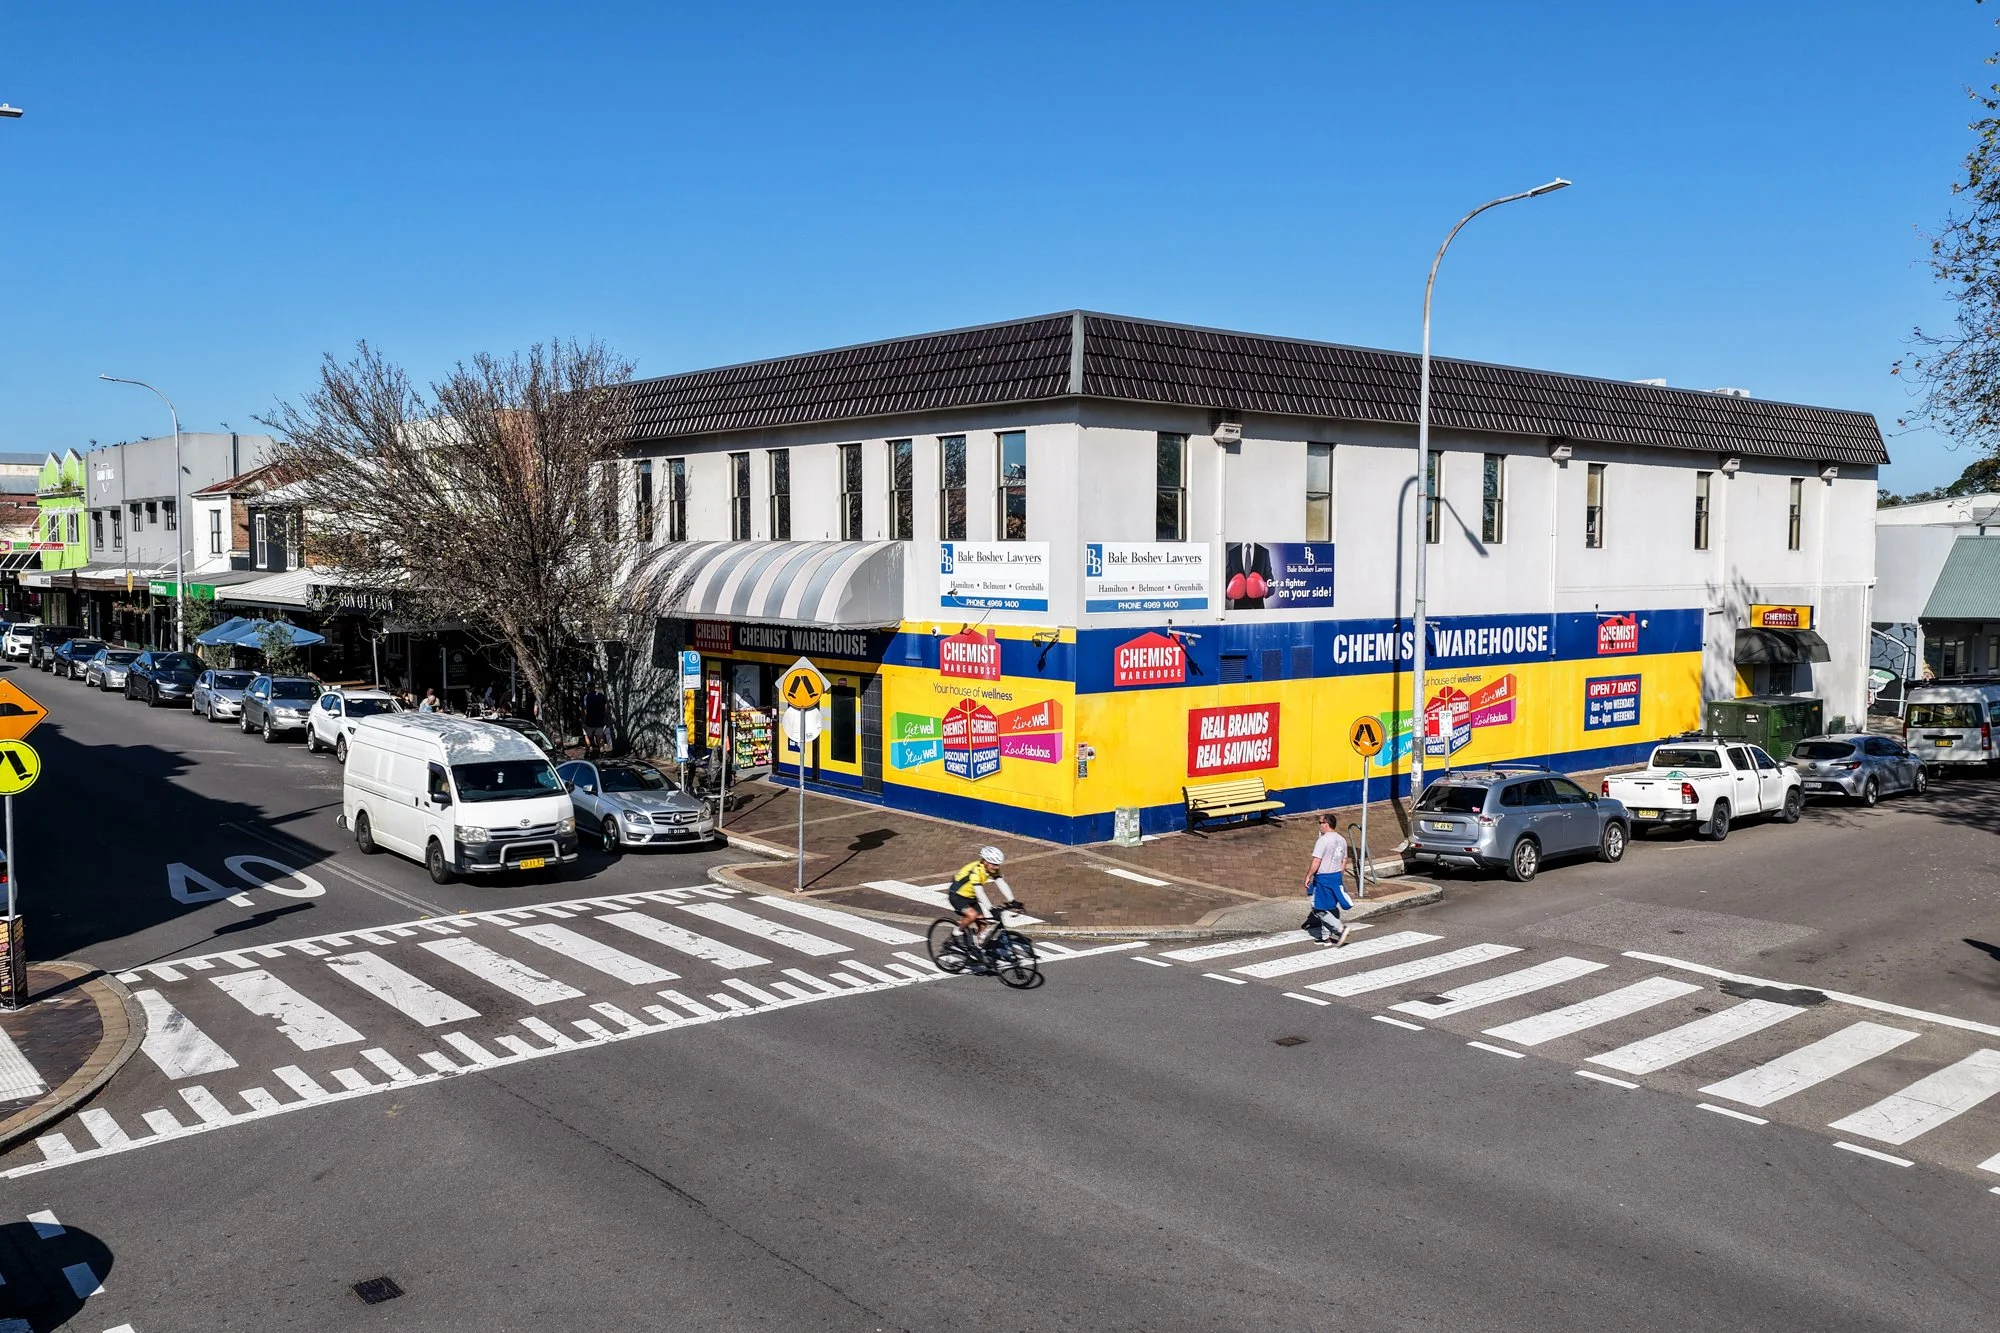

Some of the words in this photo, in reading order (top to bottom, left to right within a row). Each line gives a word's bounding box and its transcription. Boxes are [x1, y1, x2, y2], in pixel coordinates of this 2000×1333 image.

[958, 551, 974, 562] Bale
[976, 551, 1004, 562] Boshev
[1007, 552, 1042, 565] Lawyers
[1108, 551, 1128, 563] Bale
[1131, 551, 1163, 563] Boshev
[1166, 552, 1202, 565] Lawyers
[1287, 565, 1298, 573] Bale
[1298, 565, 1315, 573] Boshev
[950, 580, 975, 589] Hamilton
[983, 581, 1006, 590] Belmont
[1015, 582, 1044, 592] Greenhills
[1098, 584, 1128, 593] Hamilton
[1138, 584, 1165, 592] Belmont
[1174, 583, 1204, 592] Greenhills
[1266, 579, 1279, 587] Get
[1285, 580, 1307, 589] fighter
[1279, 590, 1290, 598] on
[1291, 589, 1310, 600] your
[1312, 586, 1332, 598] side!
[966, 599, 986, 607] PHONE
[1004, 600, 1020, 608] 1400
[1118, 601, 1141, 609] PHONE
[1143, 601, 1161, 609] 4969
[1162, 600, 1179, 608] 1400
[1764, 613, 1797, 621] CHEMIST
[695, 622, 731, 641] CHEMIST
[1600, 625, 1636, 641] CHEMIST
[696, 640, 732, 651] WAREHOUSE
[739, 626, 787, 649] CHEMIST
[791, 630, 867, 656] WAREHOUSE
[1333, 630, 1417, 664] CHEMIS
[1434, 625, 1548, 658] WAREHOUSE
[943, 641, 997, 664] CHEMIST
[1120, 646, 1182, 669] CHEMIST
[943, 663, 997, 676] WAREHOUSE
[1120, 668, 1182, 681] WAREHOUSE
[1430, 676, 1450, 685] house
[1450, 675, 1457, 684] of
[1458, 673, 1482, 683] wellness
[932, 682, 948, 694] Your
[950, 684, 972, 696] house
[973, 687, 981, 698] of
[981, 688, 1013, 701] wellness
[1590, 684, 1610, 696] OPEN
[1611, 683, 1617, 694] 7
[1619, 681, 1637, 693] DAYS
[710, 690, 719, 720] 7
[1448, 701, 1470, 715] CHEMIST
[1613, 697, 1635, 709] WEEKDAYS
[1031, 702, 1049, 726] well
[1613, 710, 1635, 722] WEEKENDS
[919, 718, 935, 735] well
[943, 720, 967, 736] CHEMIST
[971, 719, 997, 734] CHEMIST
[1200, 715, 1226, 740] REAL
[1227, 711, 1270, 738] BRANDS
[943, 736, 968, 745] WAREHOUSE
[922, 741, 938, 758] well
[944, 749, 969, 761] DISCOUNT
[973, 749, 999, 761] DISCOUNT
[1024, 743, 1051, 759] fabulous
[1196, 743, 1222, 769] REAL
[1222, 736, 1273, 766] SAVINGS!
[946, 761, 968, 775] CHEMIST
[976, 760, 998, 775] CHEMIST
[165, 854, 327, 908] 40
